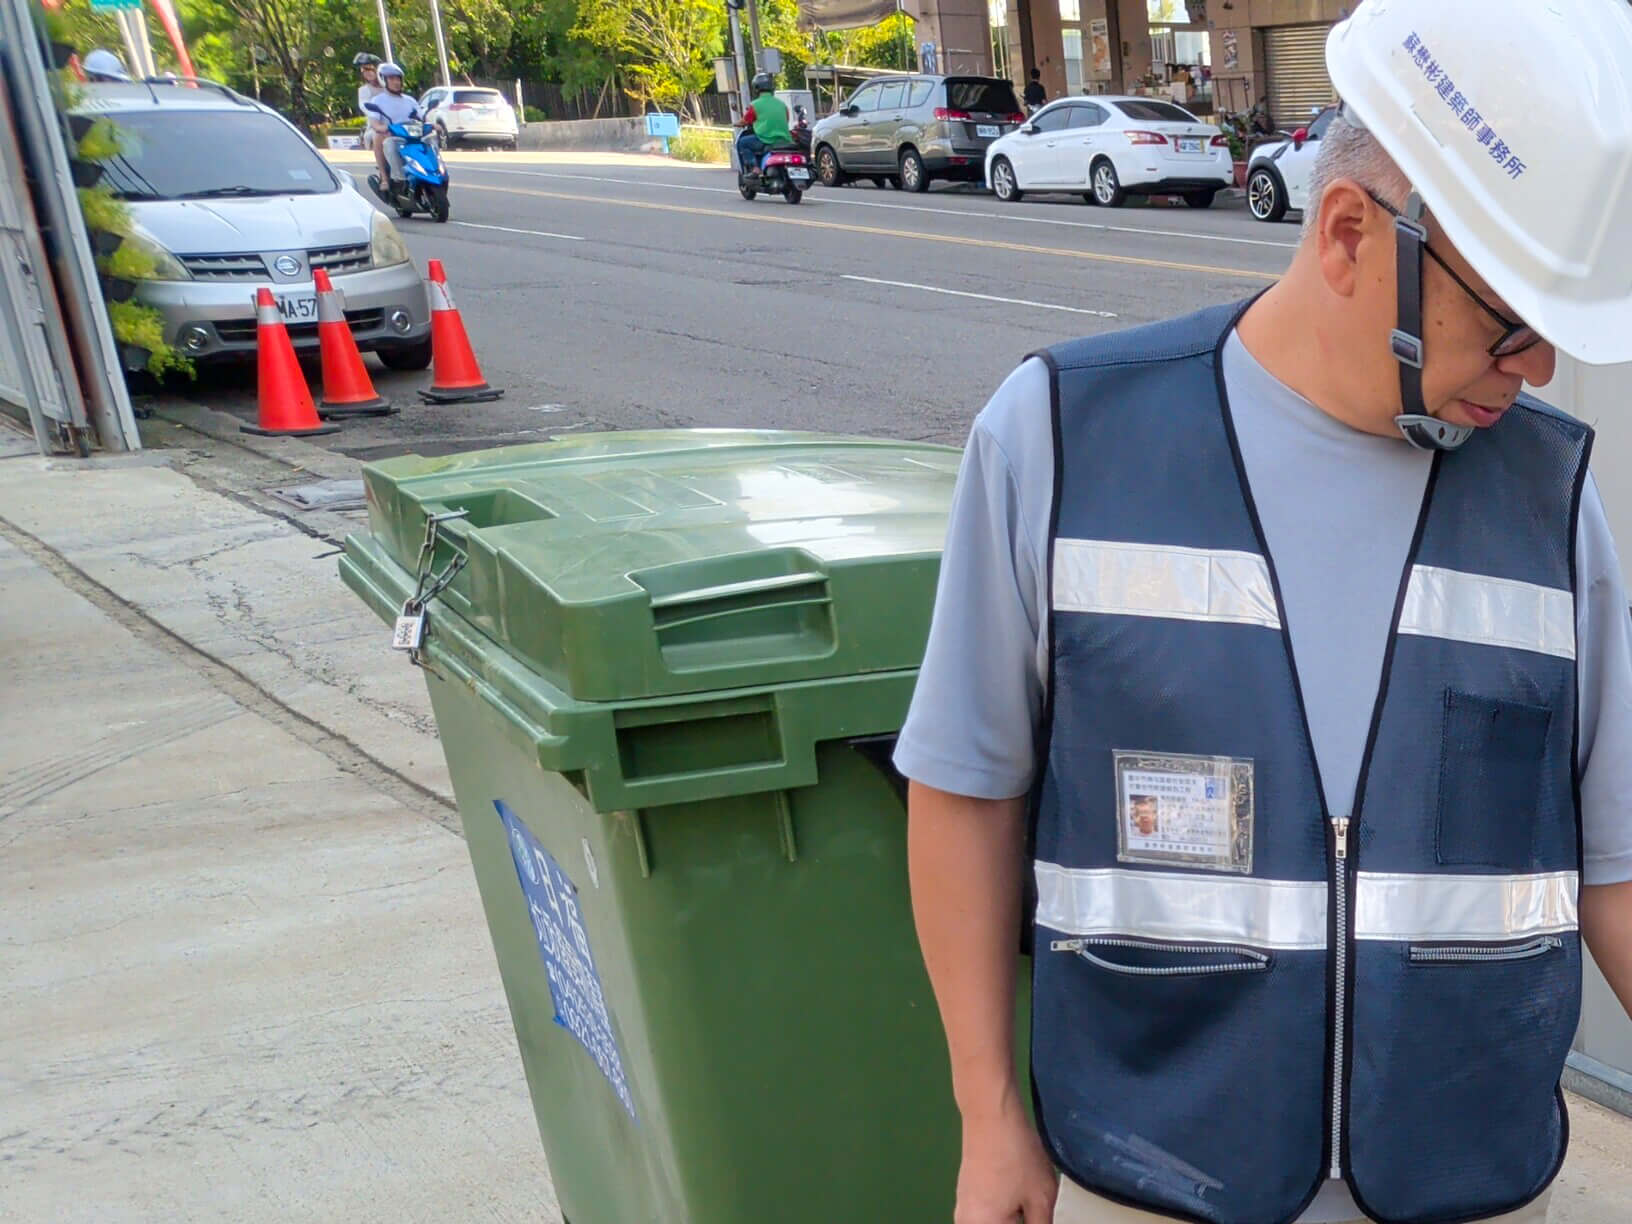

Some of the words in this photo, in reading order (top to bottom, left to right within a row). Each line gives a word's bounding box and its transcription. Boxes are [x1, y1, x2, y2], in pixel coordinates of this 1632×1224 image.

[1401, 31, 1527, 180] 蘇懋彬建築師事務所
